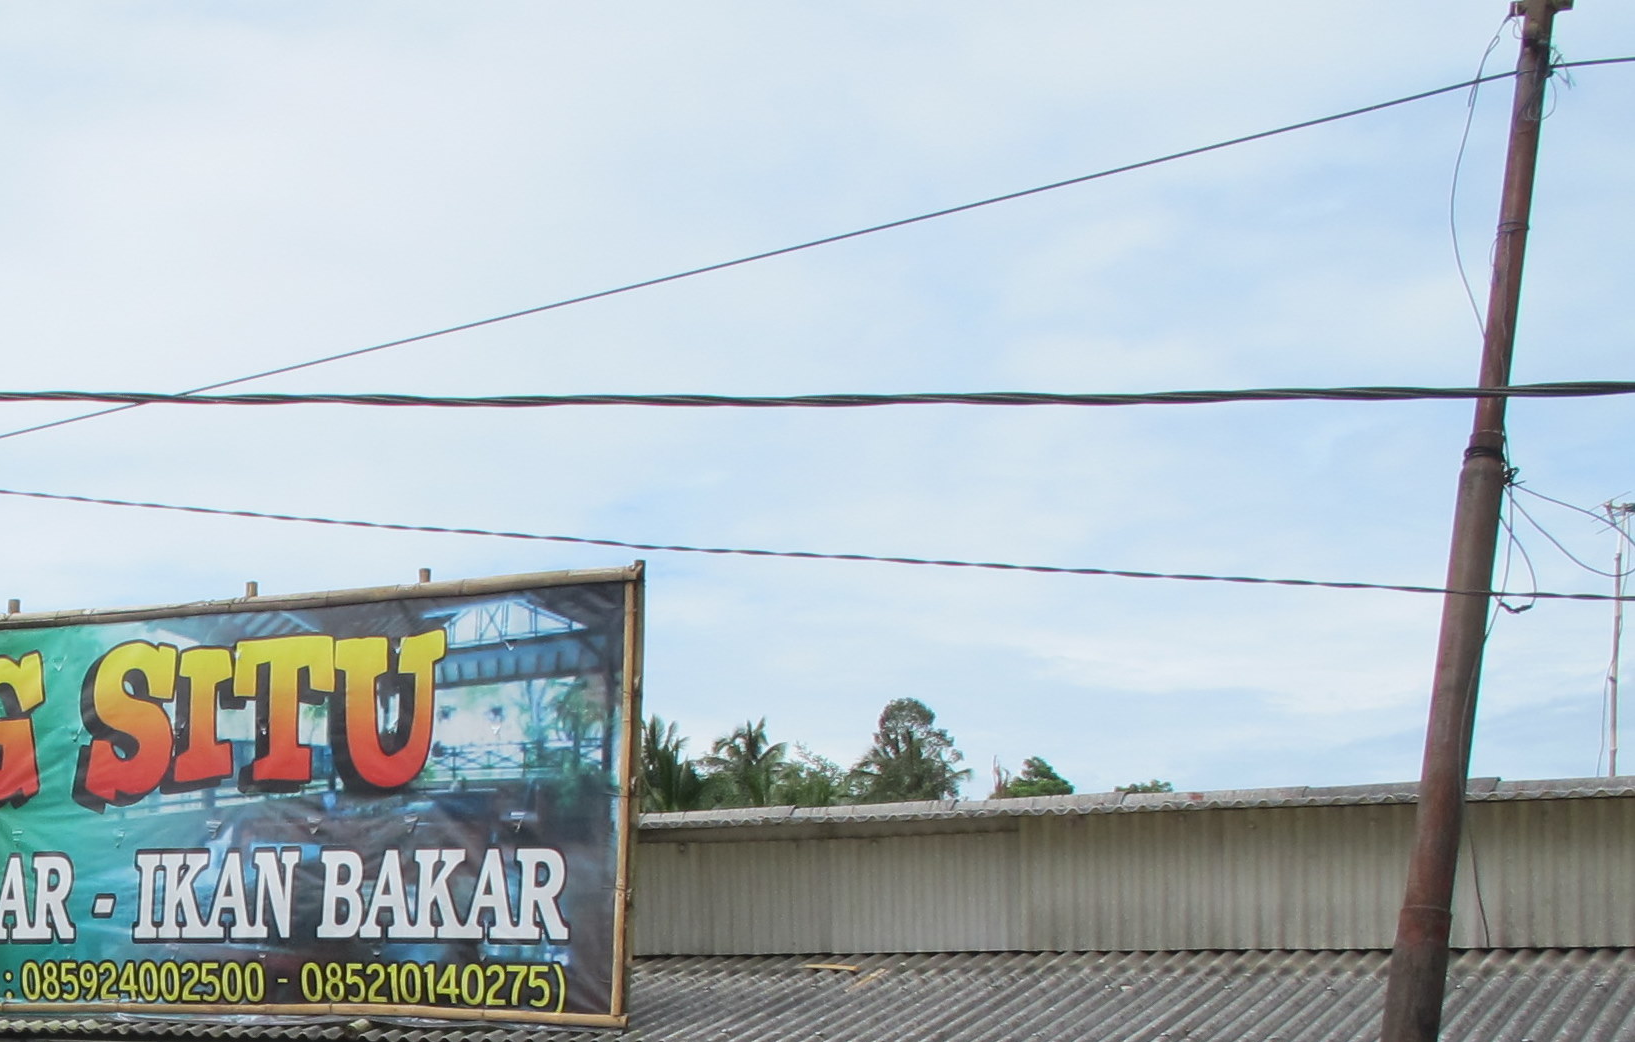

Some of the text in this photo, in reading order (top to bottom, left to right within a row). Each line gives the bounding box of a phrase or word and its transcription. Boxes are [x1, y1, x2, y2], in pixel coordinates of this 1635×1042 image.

[73, 628, 447, 813] SITU
[132, 847, 301, 944] IKAN
[315, 846, 570, 945] BAKAR
[20, 961, 266, 1003] 085924002500
[301, 961, 566, 1013] 085210140275)
